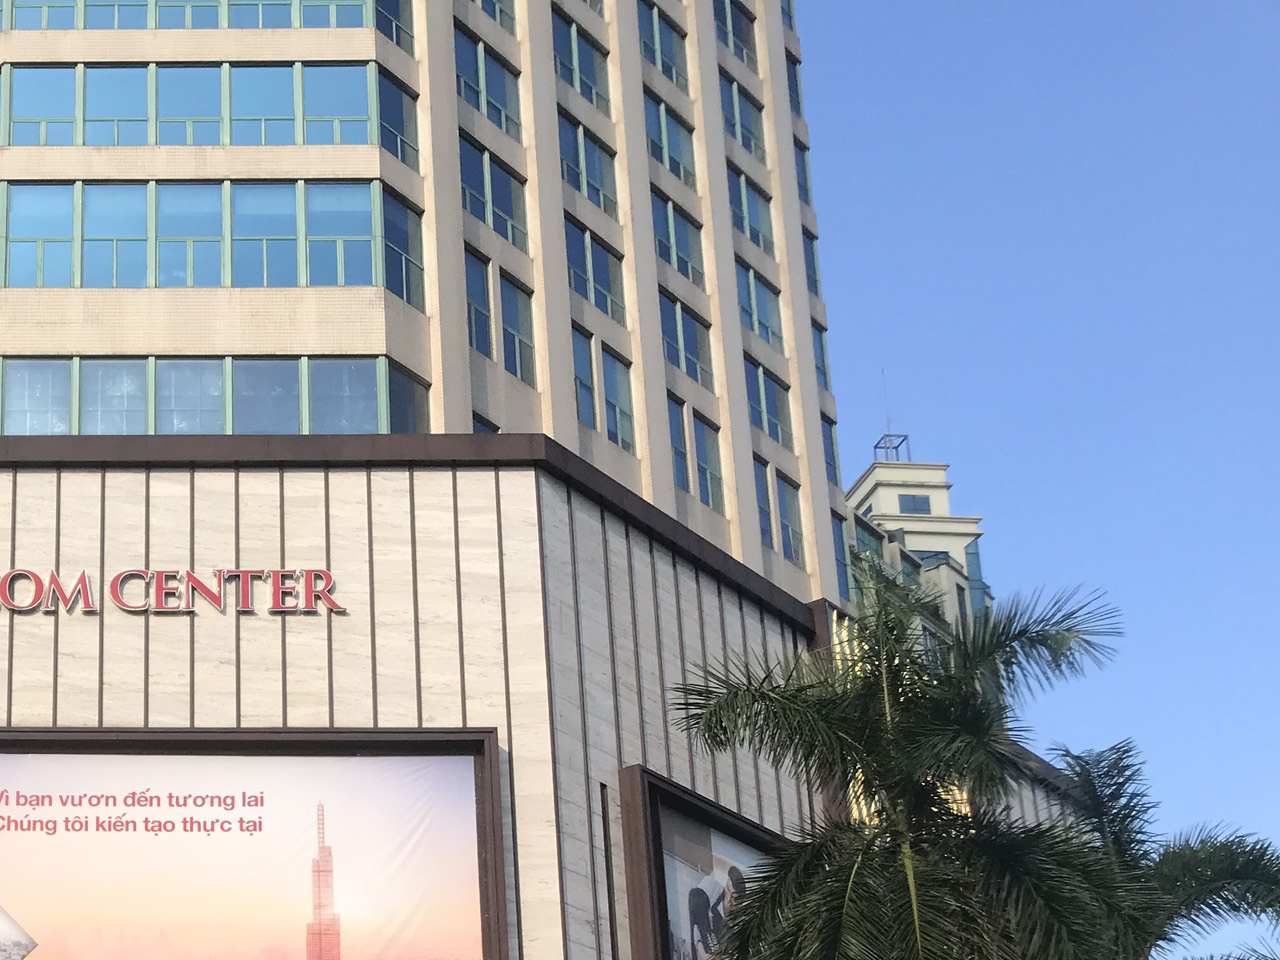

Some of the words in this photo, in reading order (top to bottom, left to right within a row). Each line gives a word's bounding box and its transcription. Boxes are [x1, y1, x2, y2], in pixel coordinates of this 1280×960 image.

[109, 568, 347, 615] CENTER
[15, 790, 53, 811] bạn
[59, 793, 117, 807] vươn
[123, 788, 161, 807] đến
[166, 792, 235, 811] tương
[241, 791, 264, 807] lai
[63, 815, 89, 832] tôi
[95, 812, 137, 832] kiến
[143, 817, 176, 836] tạo
[182, 816, 232, 837] thực
[238, 816, 263, 836] tại
